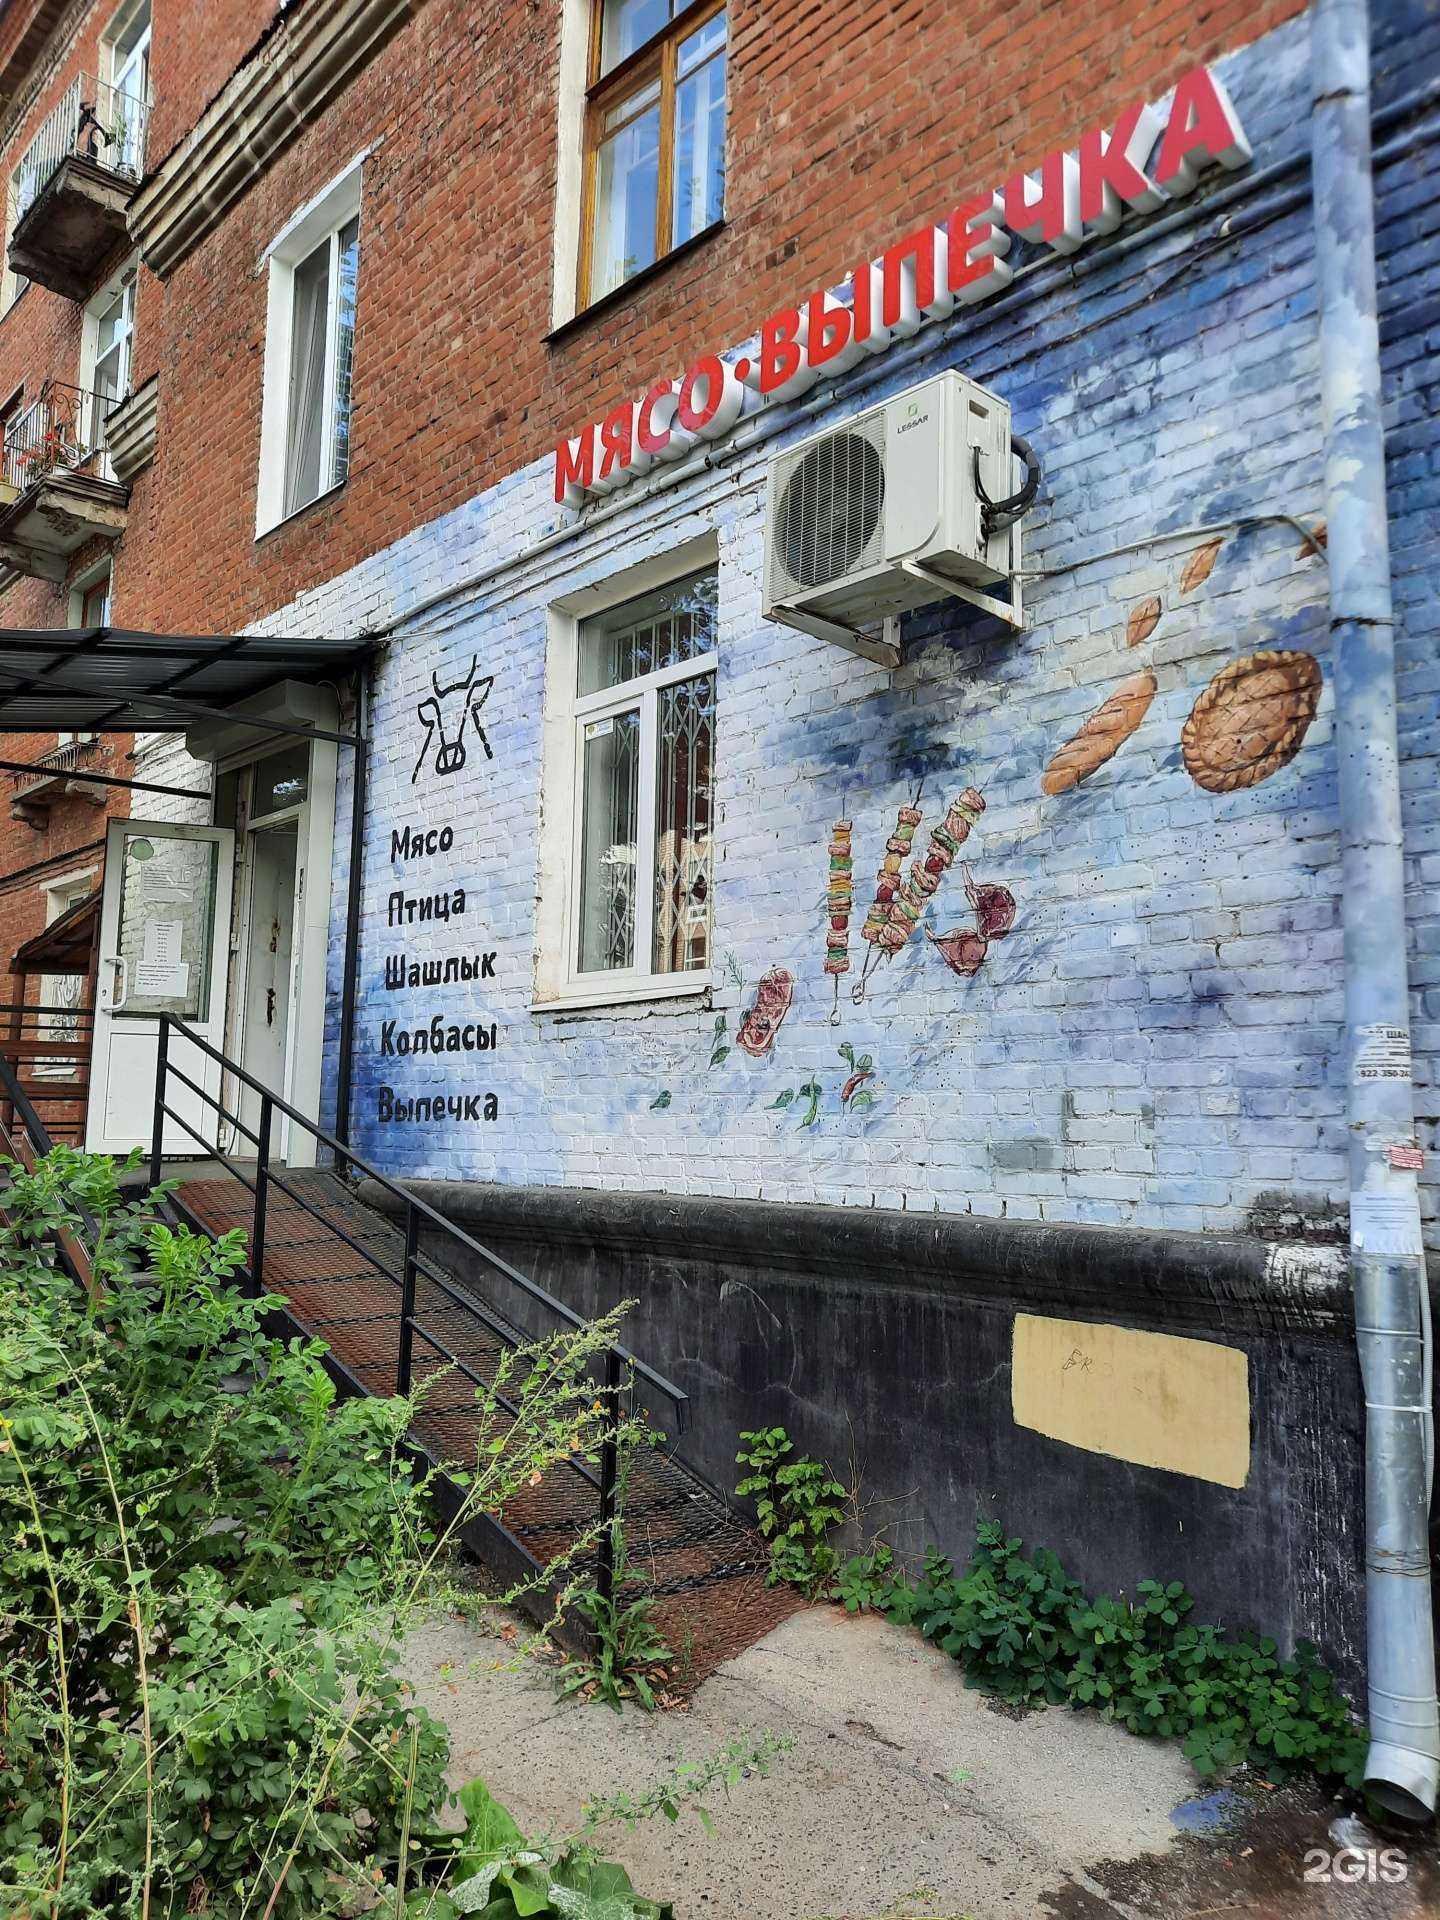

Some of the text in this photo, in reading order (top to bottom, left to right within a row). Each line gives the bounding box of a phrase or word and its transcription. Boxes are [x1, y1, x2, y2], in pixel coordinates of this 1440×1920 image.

[555, 66, 1237, 504] МЯСО ВЫПЕЧКА
[897, 414, 929, 434] LESSAR
[390, 825, 454, 863] Мясо
[388, 888, 466, 927] Птица
[385, 951, 498, 990] Шашлык
[381, 1015, 498, 1056] Колбасы
[378, 1086, 499, 1122] Выпечка
